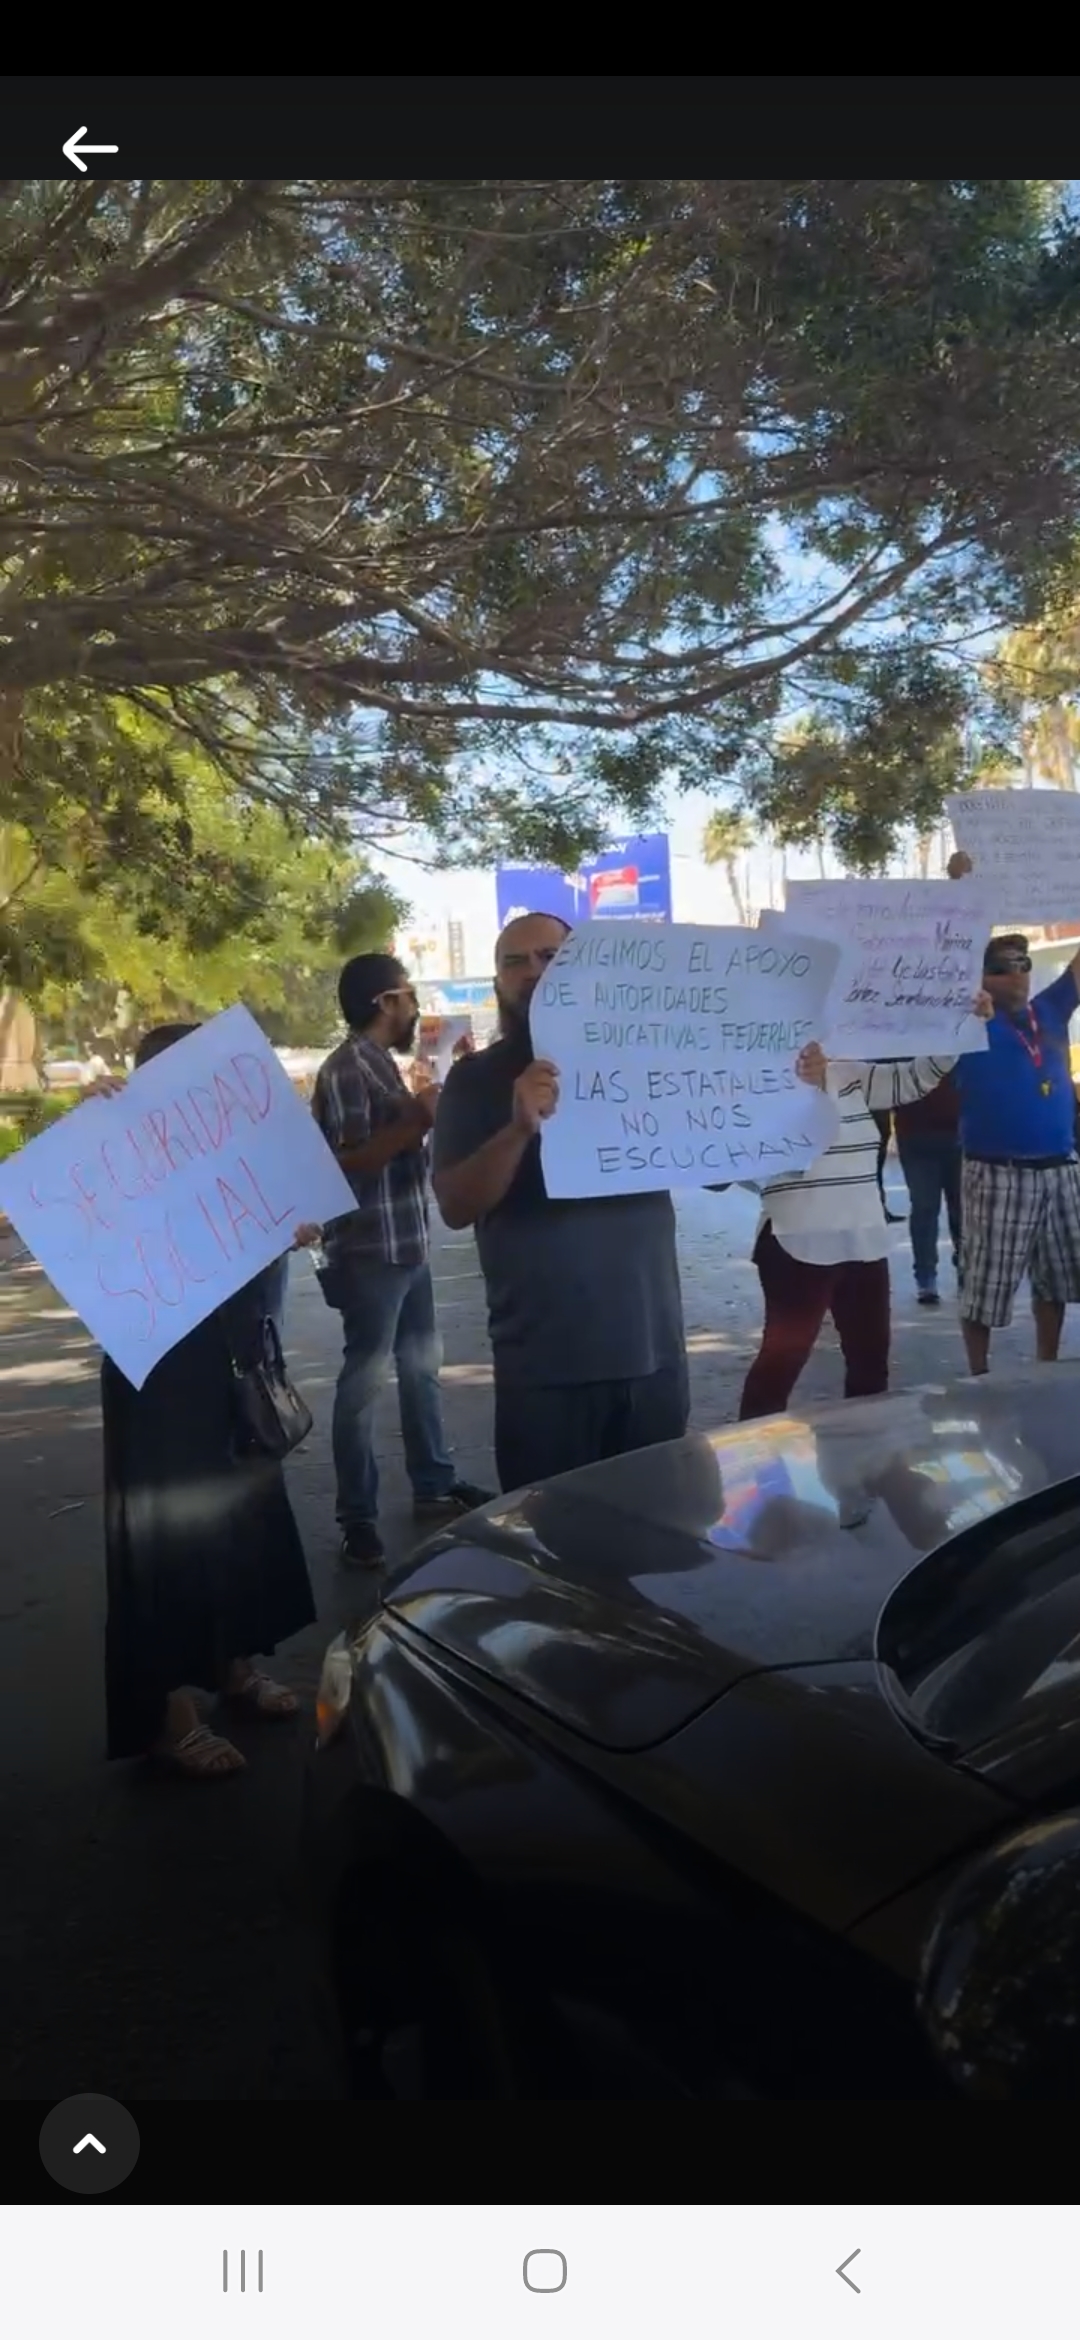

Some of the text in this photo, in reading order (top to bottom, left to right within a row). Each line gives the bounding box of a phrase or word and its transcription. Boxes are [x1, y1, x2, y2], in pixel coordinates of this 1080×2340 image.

[554, 936, 811, 978] EXIGIMOS EL APOYO
[543, 981, 729, 1015] DE AUTORIDADES
[585, 1021, 711, 1050] EDUCATIVAS
[575, 1066, 796, 1103] LAS ESTATALES
[620, 1103, 753, 1138] NO NOS
[29, 1053, 274, 1245] SEGURIDAD
[597, 1133, 813, 1173] ESCUCHAN
[97, 1156, 296, 1344] SOCIAL
